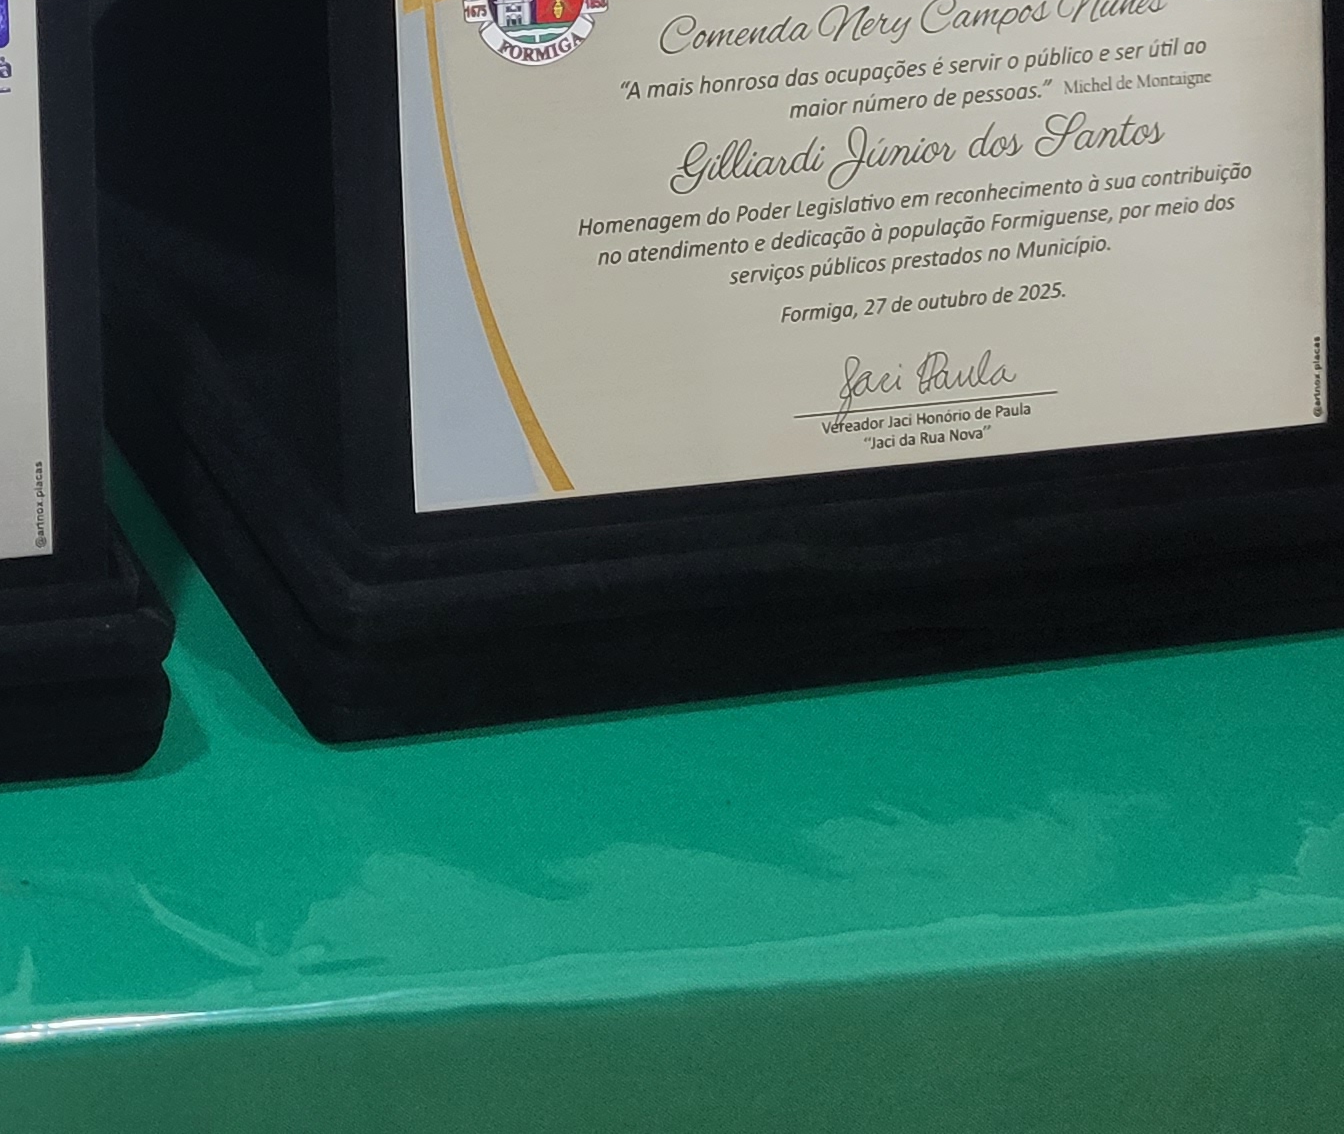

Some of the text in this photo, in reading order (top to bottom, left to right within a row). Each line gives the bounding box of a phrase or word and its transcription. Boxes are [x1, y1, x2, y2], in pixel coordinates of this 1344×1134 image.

[498, 32, 586, 62] FORMIGA
[659, 14, 813, 56] Comenda
[817, 4, 914, 51] Nery
[669, 111, 1165, 195] Gilliardi Júnior dos Santos
[578, 162, 1253, 237] Homenagem do Poder Legislativo em reconhecimento à sua contribuição
[729, 235, 1111, 286] serviços públicos prestados no Município.
[780, 281, 1066, 323] Formiga, 27 de outubro de 2025.
[821, 402, 1032, 435] Vereador Jaci Honório de Paula
[898, 433, 917, 447] da
[919, 431, 946, 445] Rua
